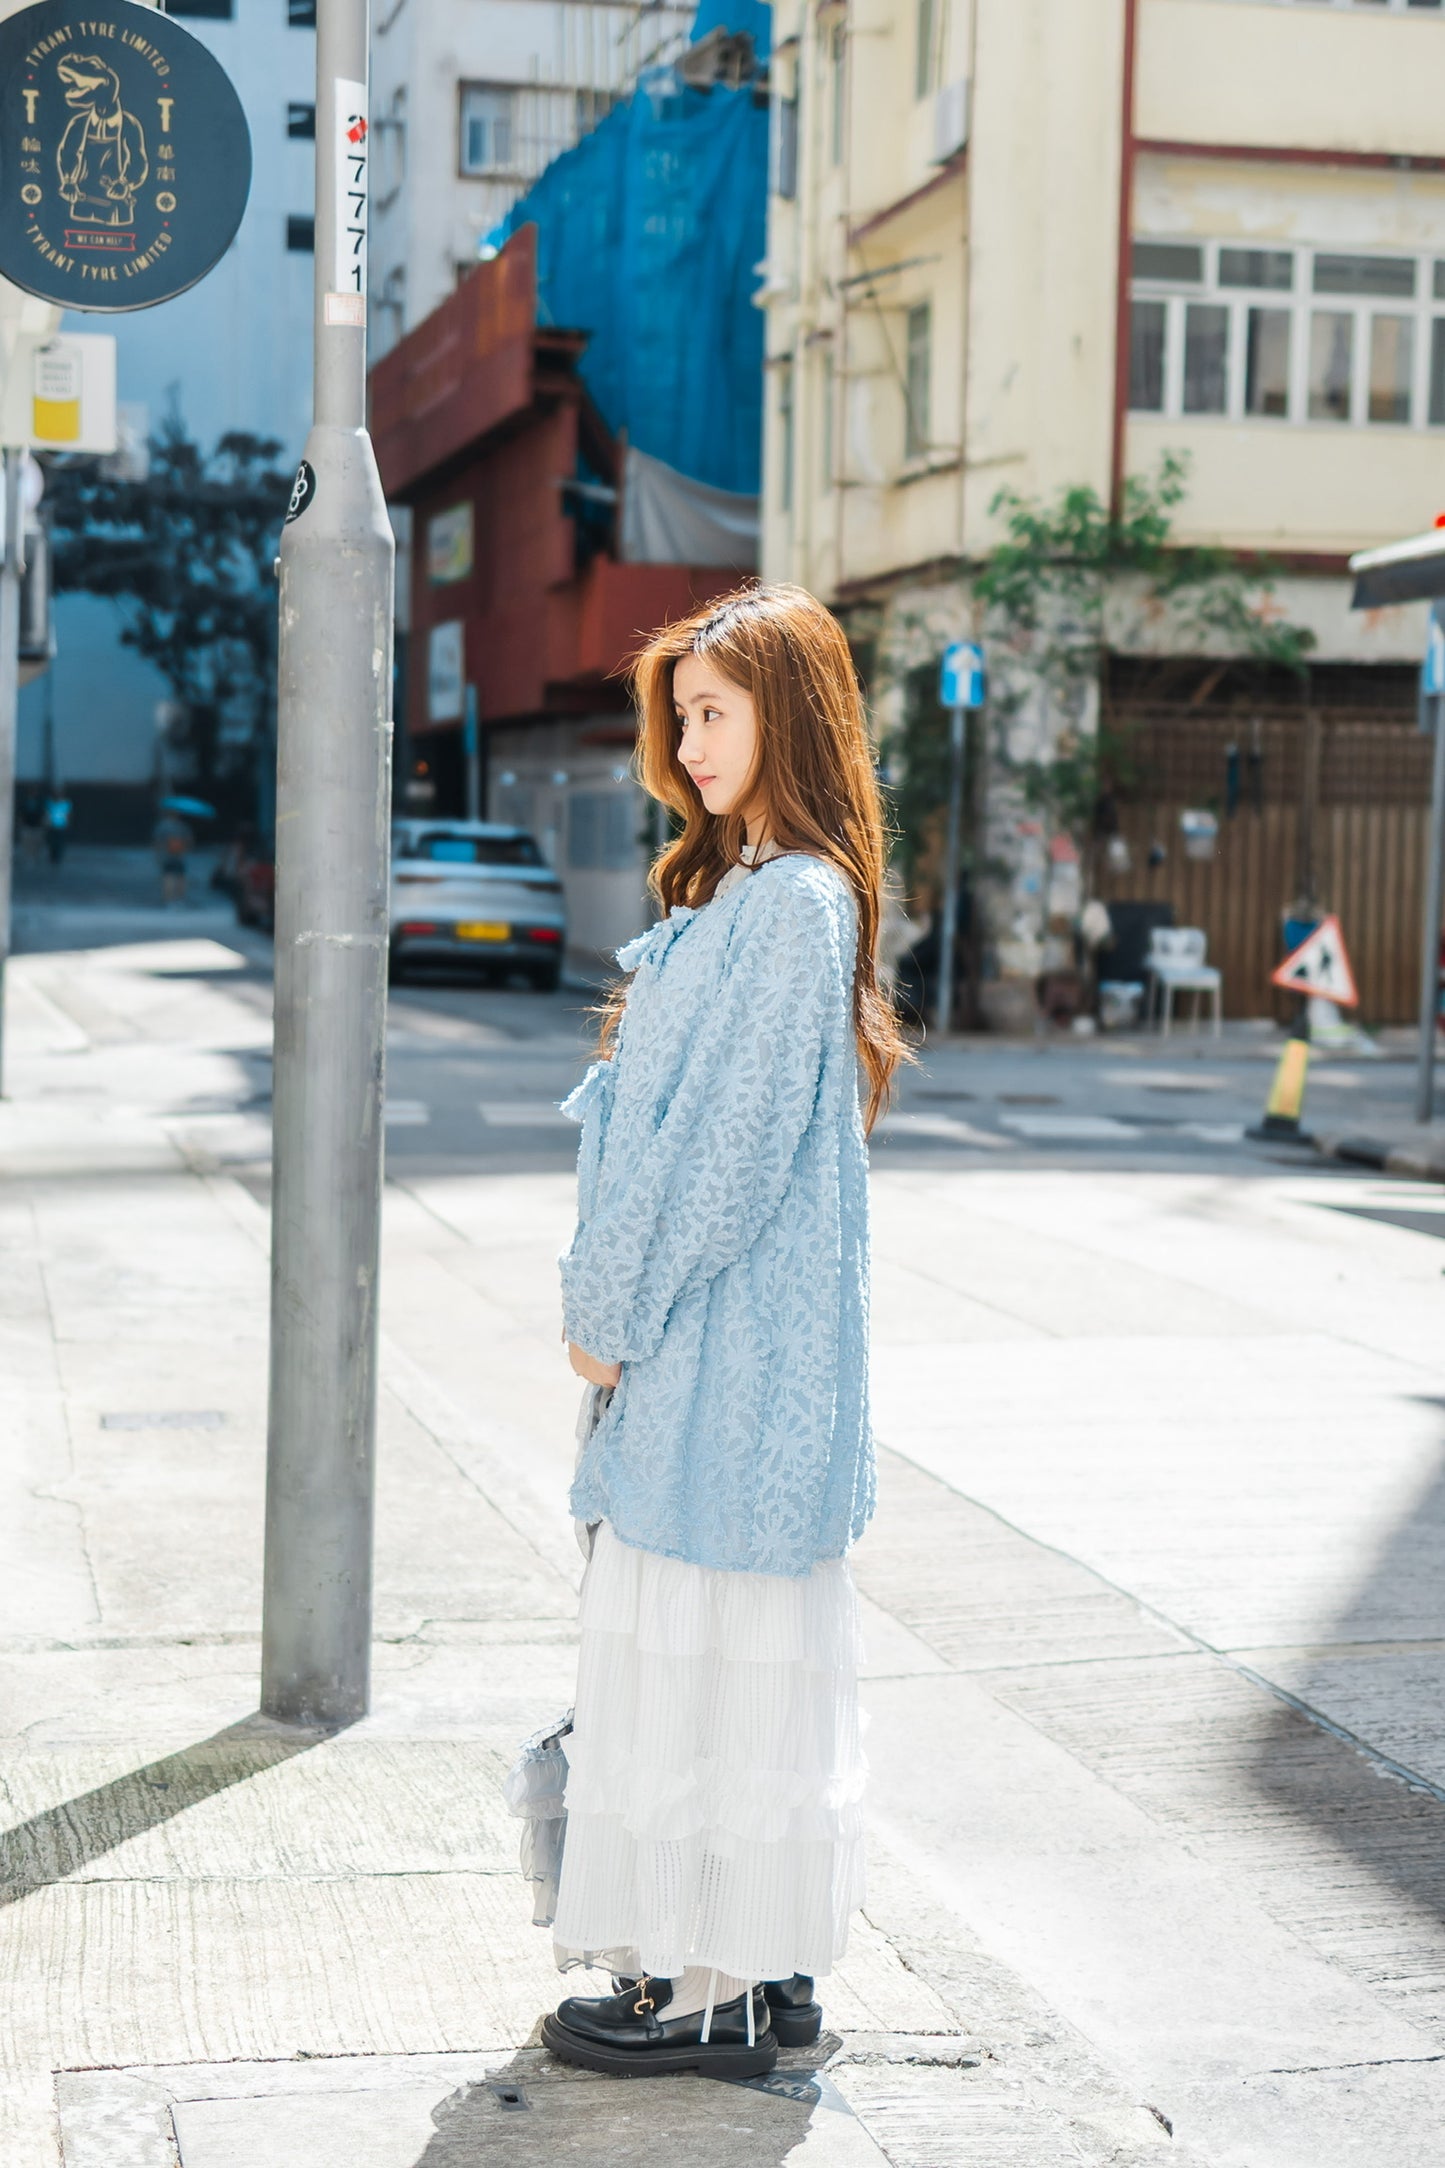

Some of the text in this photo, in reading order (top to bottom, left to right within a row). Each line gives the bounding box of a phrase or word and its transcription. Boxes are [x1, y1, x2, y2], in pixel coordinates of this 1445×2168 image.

[26, 21, 170, 76] TYRANT TYRE LIMITED
[26, 224, 172, 281] TYRANT TYRE LIMITED
[90, 235, 104, 245] CAN
